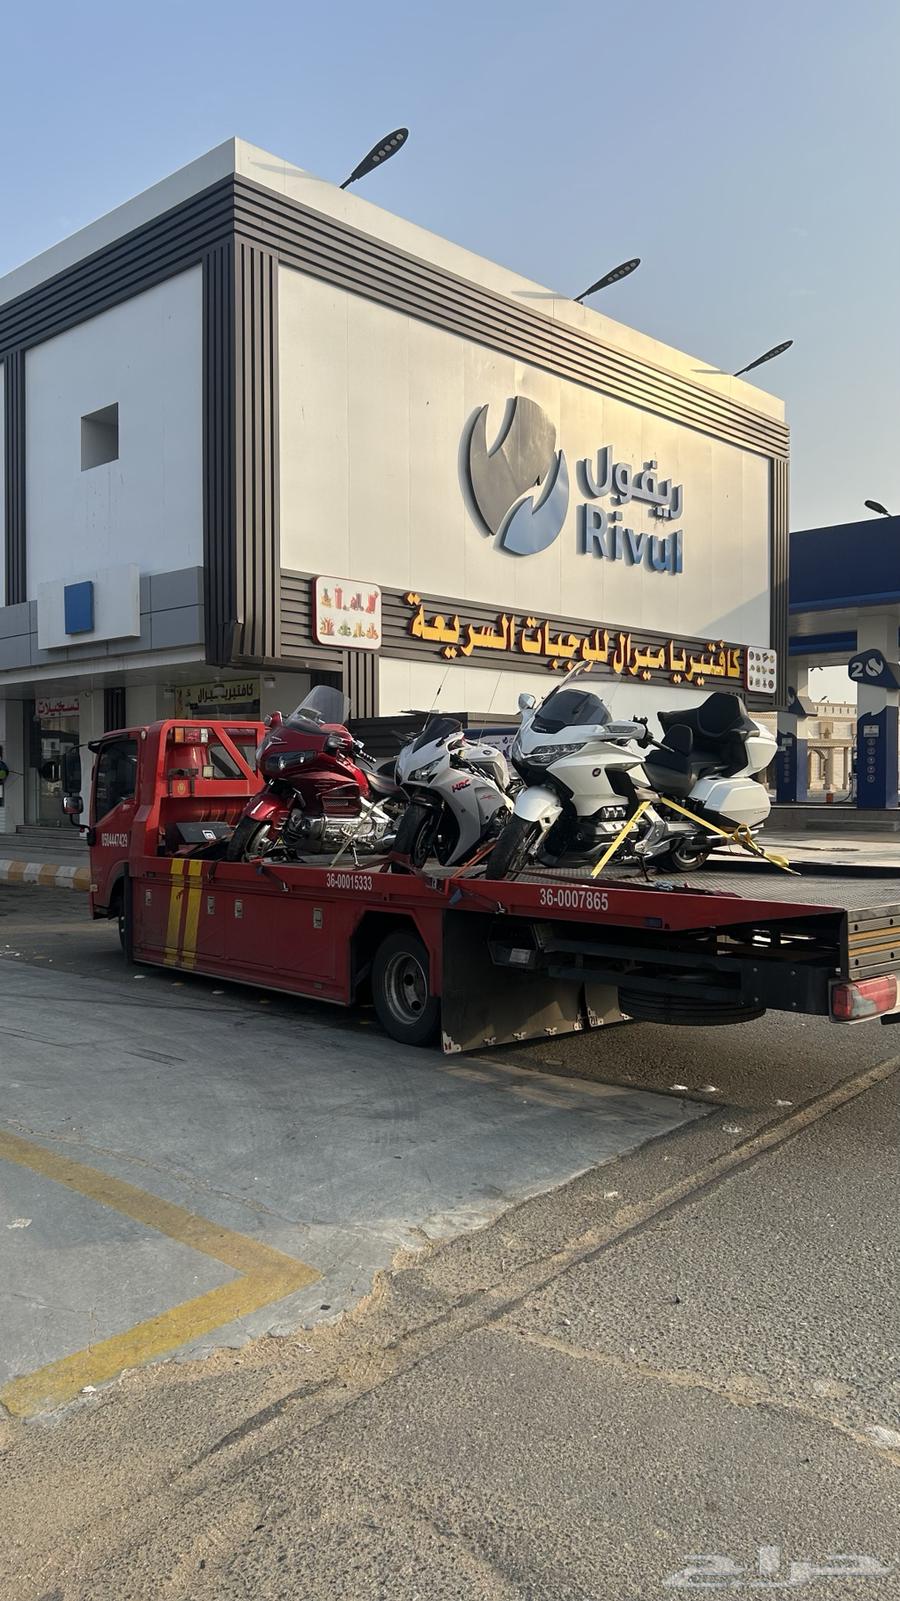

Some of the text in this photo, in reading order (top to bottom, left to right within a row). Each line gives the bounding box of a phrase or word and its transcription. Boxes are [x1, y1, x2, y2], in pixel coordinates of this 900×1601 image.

[580, 503, 683, 574] Rivul
[403, 592, 741, 687] كافتيريا ميرال للوجبات السريعة
[851, 662, 864, 678] 2
[452, 779, 471, 793] HRC
[326, 873, 373, 891] 36-00015333
[539, 888, 609, 911] 36-0007865
